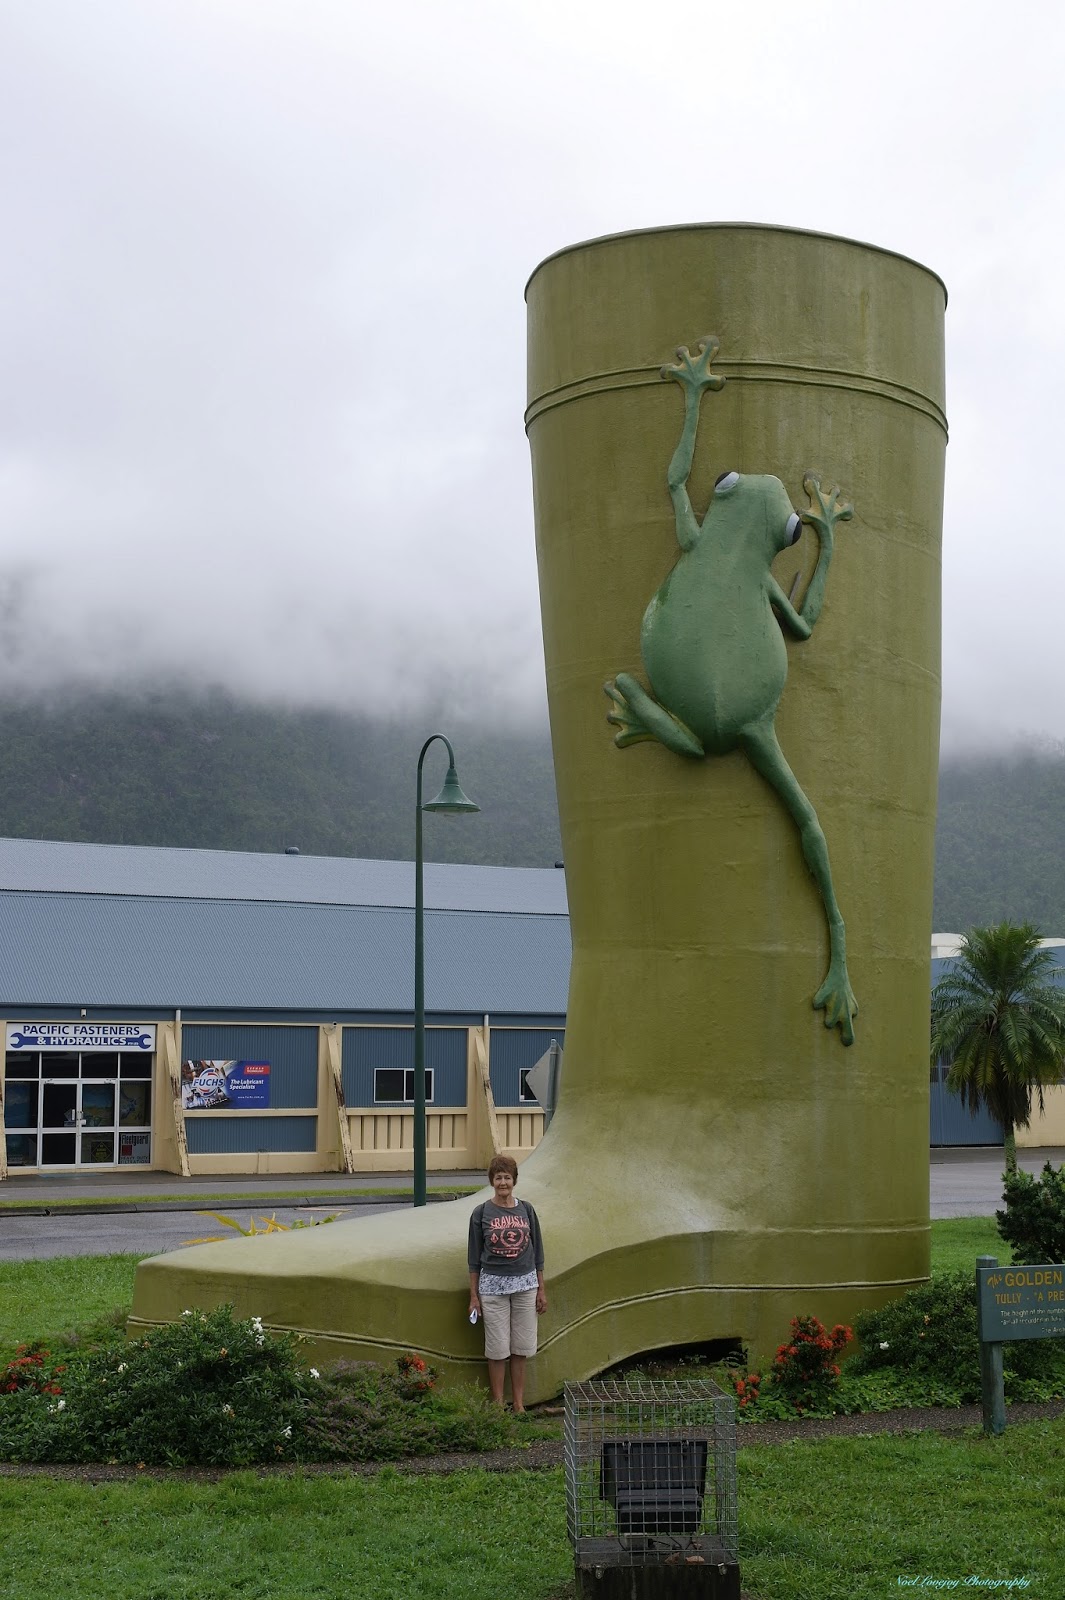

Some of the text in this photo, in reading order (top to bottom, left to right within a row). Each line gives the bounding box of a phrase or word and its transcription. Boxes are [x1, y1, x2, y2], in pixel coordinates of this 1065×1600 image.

[23, 1025, 140, 1036] PACIFIC FASTENERS
[37, 1036, 46, 1045] &
[50, 1037, 127, 1046] HYDRAULICS
[193, 1078, 225, 1087] FUCHS
[122, 1134, 149, 1146] Fleetguard
[1004, 1270, 1063, 1287] GOLDEN
[995, 1292, 1022, 1305] TULLY
